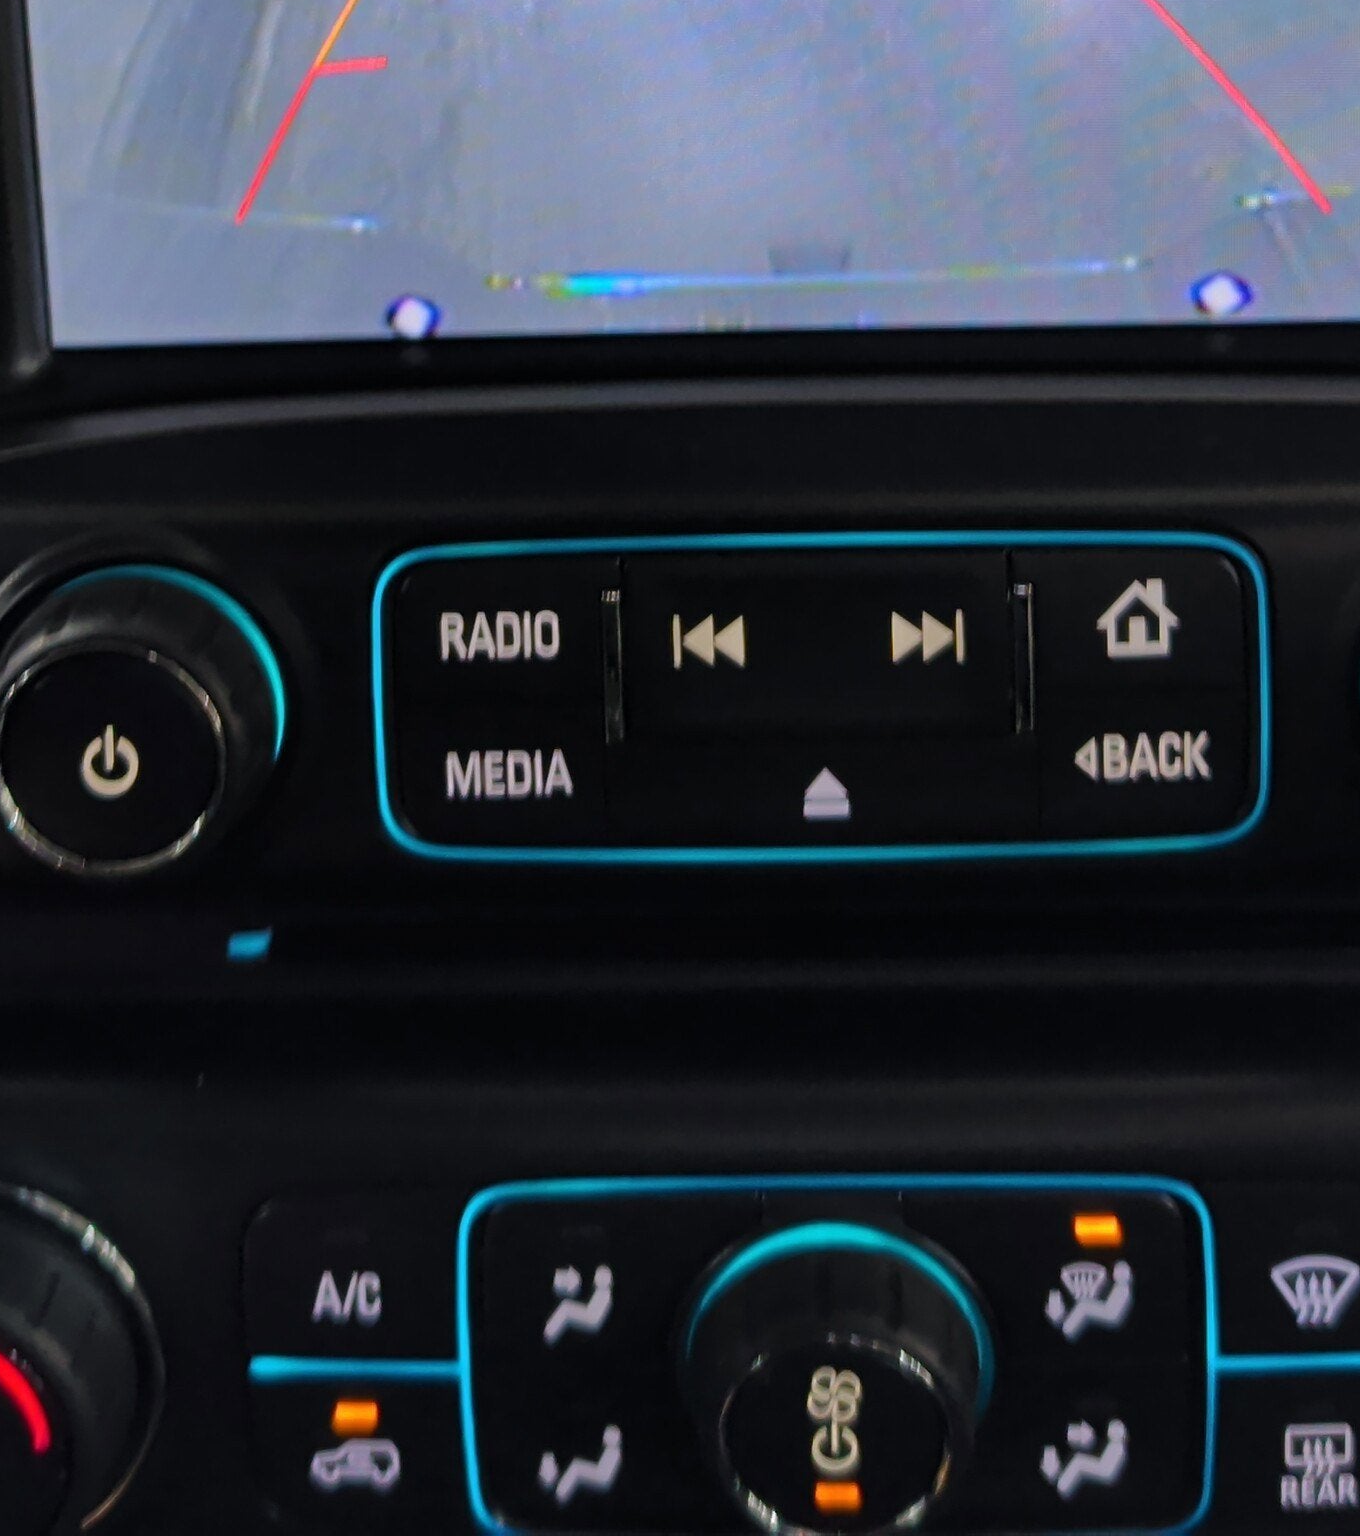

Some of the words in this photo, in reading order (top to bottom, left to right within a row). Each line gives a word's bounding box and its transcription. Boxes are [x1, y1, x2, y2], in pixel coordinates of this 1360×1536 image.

[440, 610, 561, 661] RADIO
[446, 748, 574, 800] MEDIA
[1102, 730, 1213, 783] BACK
[312, 1269, 383, 1325] A/C
[1280, 1473, 1359, 1509] REAR
